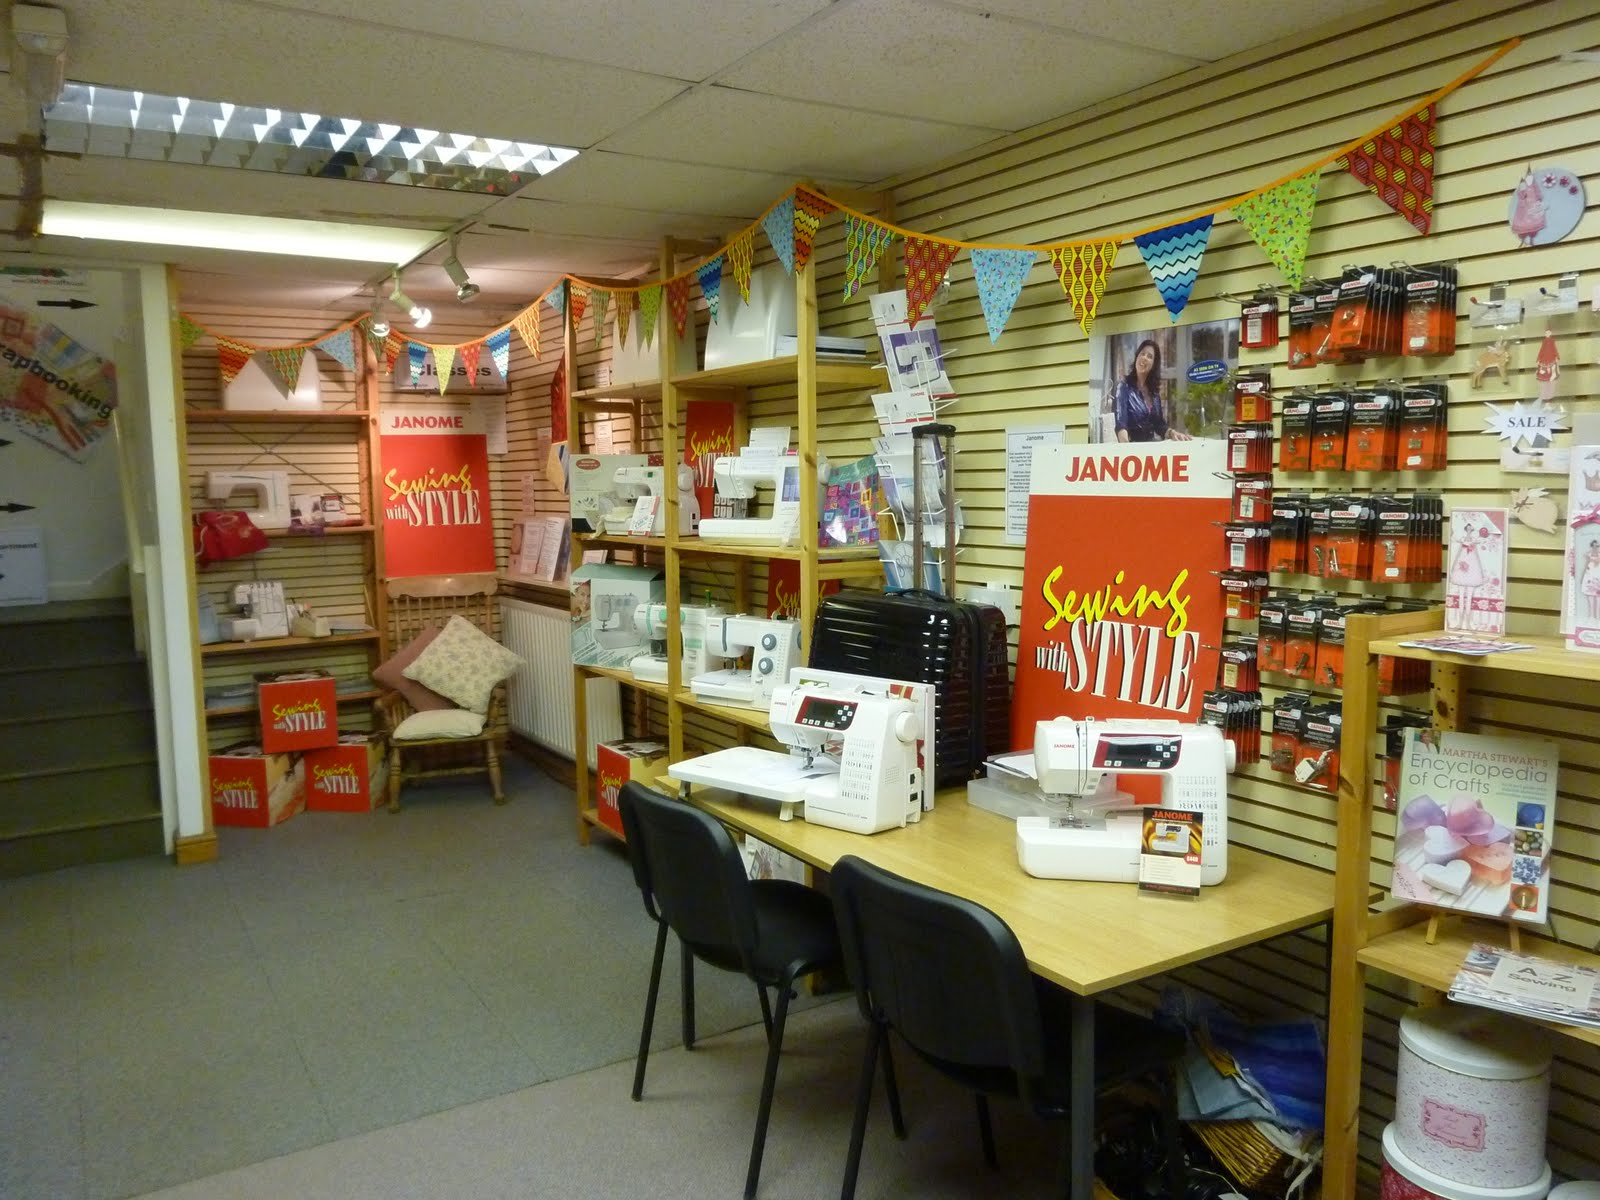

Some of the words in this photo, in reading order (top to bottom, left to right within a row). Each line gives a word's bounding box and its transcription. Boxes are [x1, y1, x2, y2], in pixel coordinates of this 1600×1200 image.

[412, 364, 492, 376] lsss
[391, 416, 464, 429] JANOME
[1507, 416, 1547, 429] SALE
[691, 425, 732, 462] Sewing
[1065, 455, 1190, 483] JANOME
[384, 463, 472, 501] Sewing
[385, 504, 409, 520] with
[406, 489, 481, 527] STYLE
[776, 579, 800, 616] Sew
[1042, 564, 1191, 638] Sewing
[1035, 640, 1068, 673] with
[1064, 617, 1200, 714] STYLE
[272, 698, 321, 721] Sewing
[285, 710, 326, 733] STYLE
[1411, 752, 1548, 783] Encyclopedia
[1442, 748, 1488, 761] MARTHA
[1489, 753, 1548, 768] STEWART'S
[323, 775, 359, 793] STYLE
[1409, 771, 1428, 786] of
[1433, 773, 1490, 795] Crafts
[222, 789, 258, 809] STYLE
[1152, 810, 1194, 821] JANOME
[1508, 973, 1577, 992] Sewing
